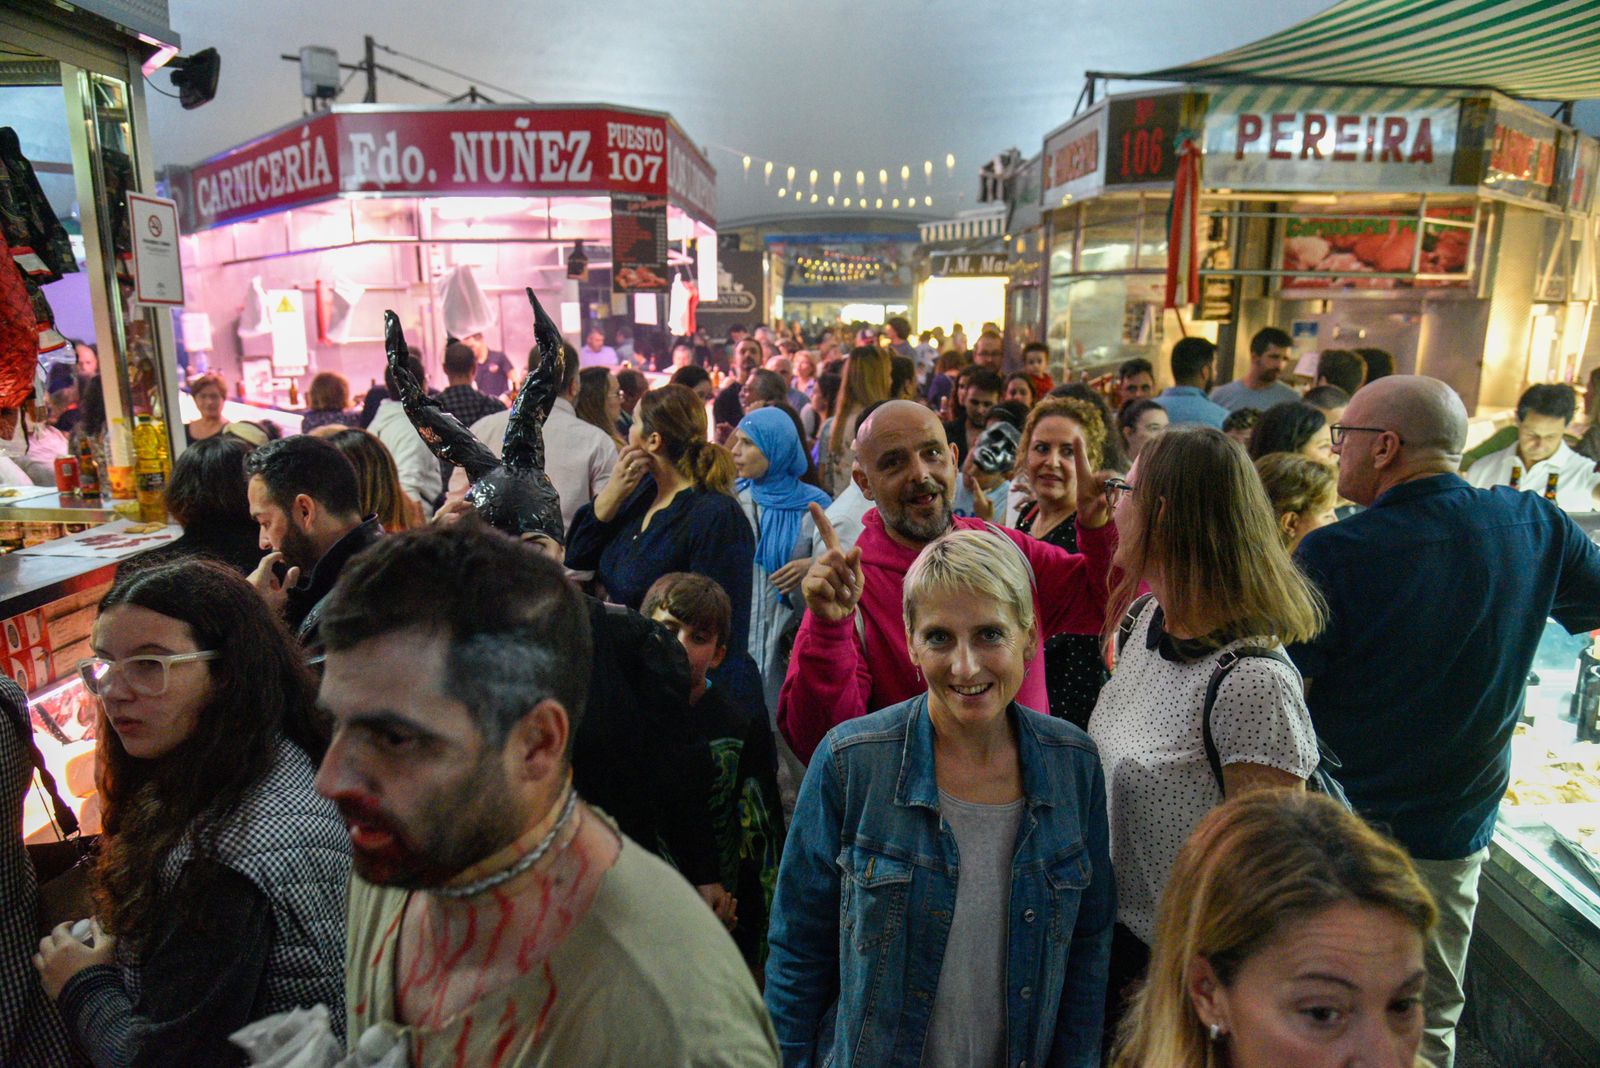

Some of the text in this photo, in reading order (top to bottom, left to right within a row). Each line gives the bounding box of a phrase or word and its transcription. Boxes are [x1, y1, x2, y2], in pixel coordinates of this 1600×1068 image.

[348, 116, 593, 184] Fdo. NUÑEZ
[606, 121, 664, 153] PUESTO
[1121, 127, 1164, 176] 106
[1234, 112, 1434, 164] PEREIRA
[199, 125, 333, 218] CARNICERÍA
[607, 151, 663, 184] 107
